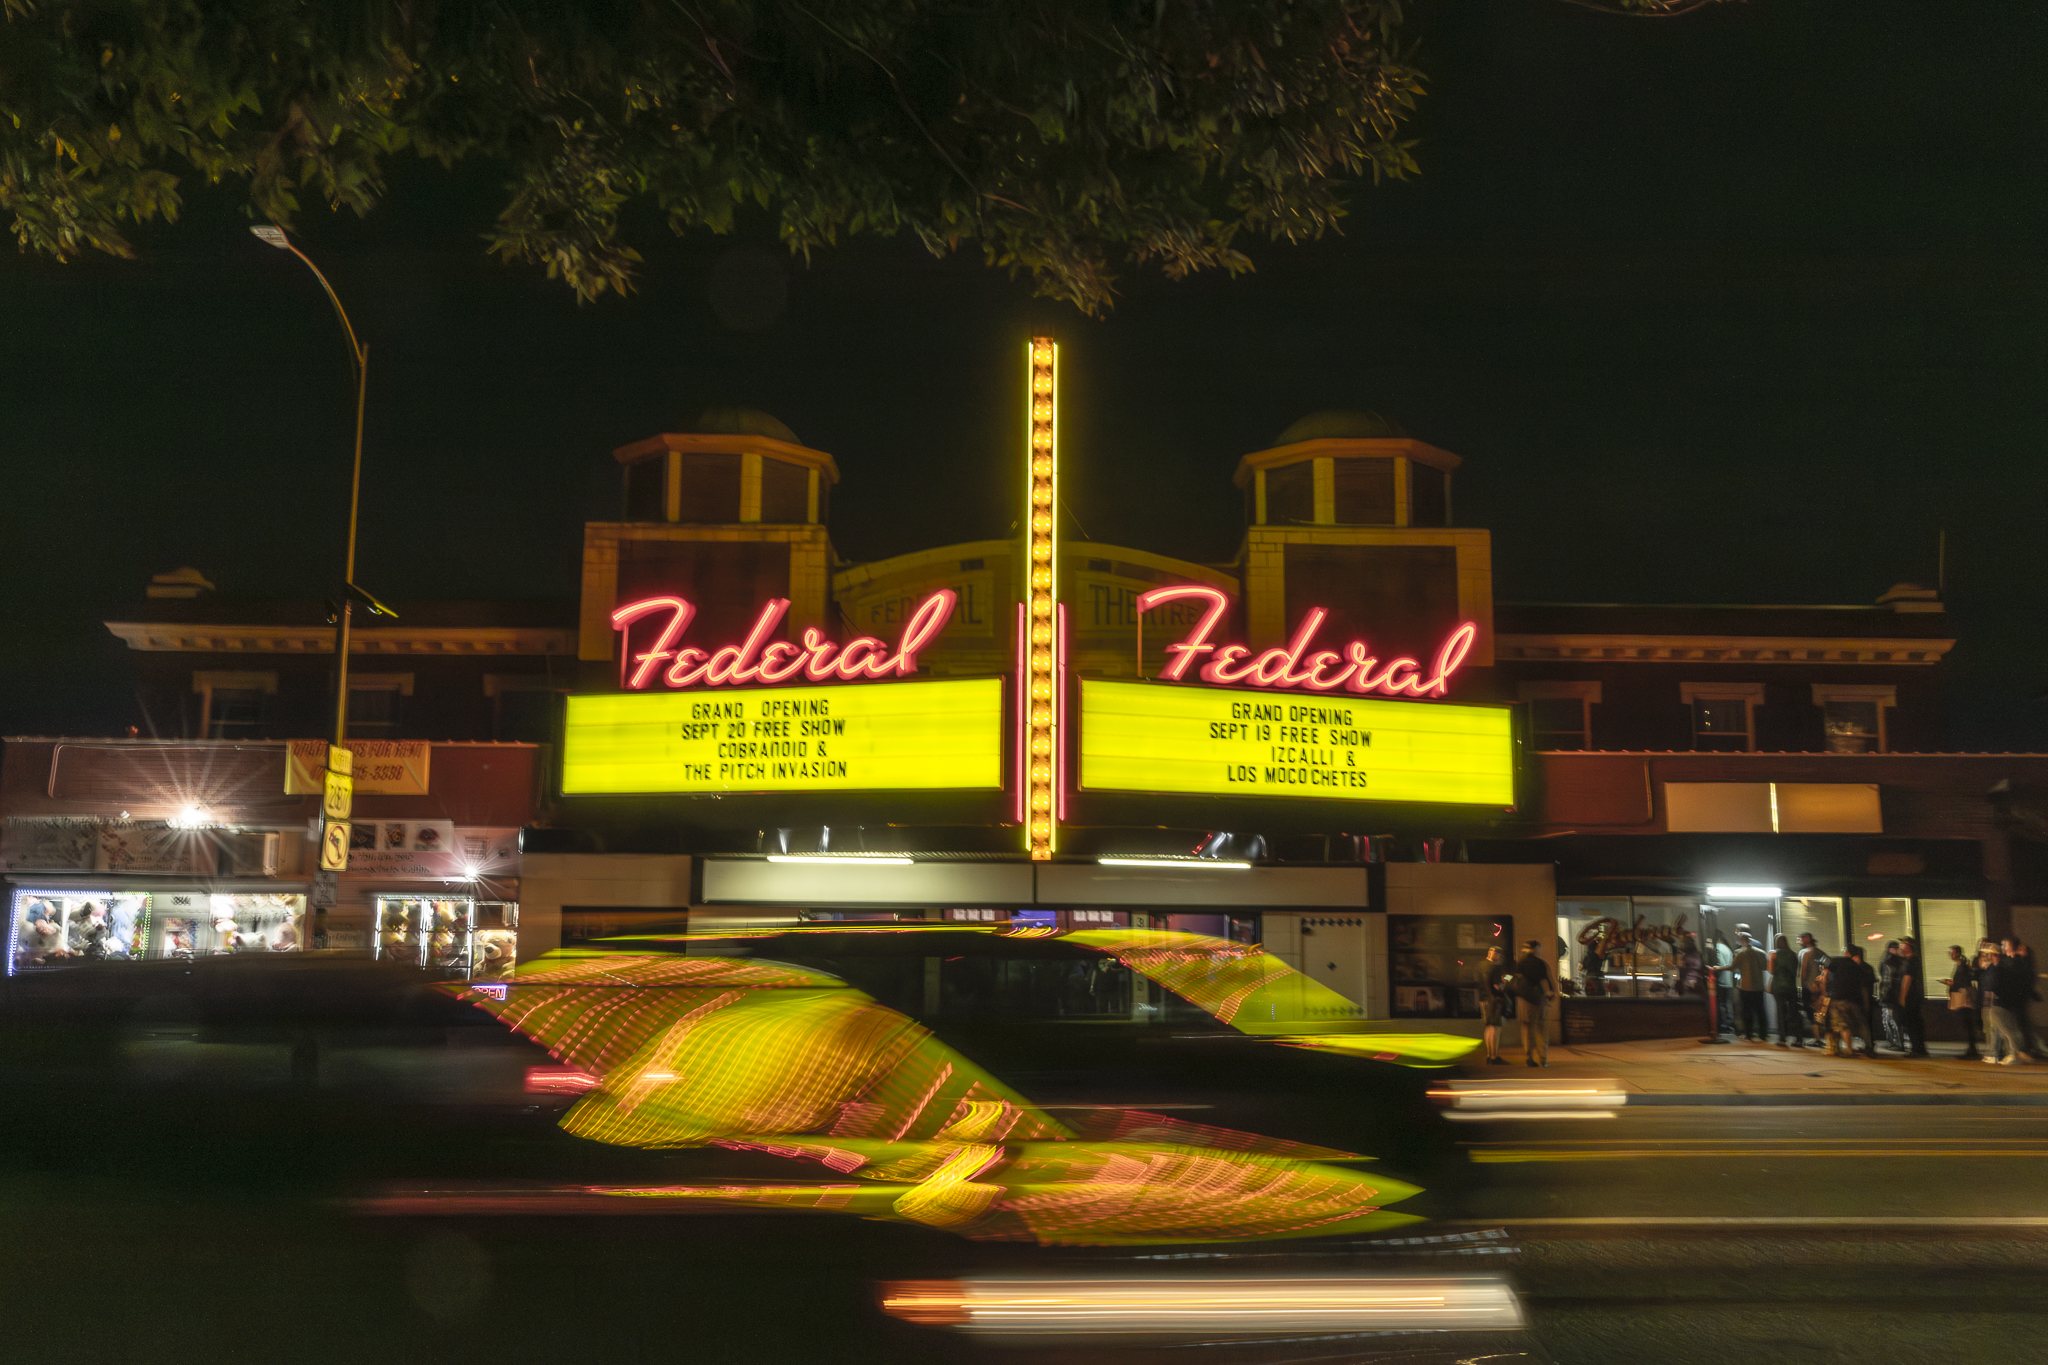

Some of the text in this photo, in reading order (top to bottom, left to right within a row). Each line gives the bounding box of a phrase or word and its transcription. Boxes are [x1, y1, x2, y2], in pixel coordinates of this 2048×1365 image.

[612, 588, 957, 689] Federal
[1136, 585, 1477, 698] Federal
[692, 699, 830, 720] GRAND OPENING
[1231, 702, 1353, 726] GRAND OPENING
[682, 719, 846, 740] SEPT 20 FREE SHOW
[1209, 722, 1372, 747] SEPT 19 FREE SHOW
[718, 740, 828, 759] COBRANOID &
[1271, 746, 1356, 767] IZCALLI &
[684, 761, 847, 780] THE PITCH INVASION
[1227, 764, 1257, 783] LOS
